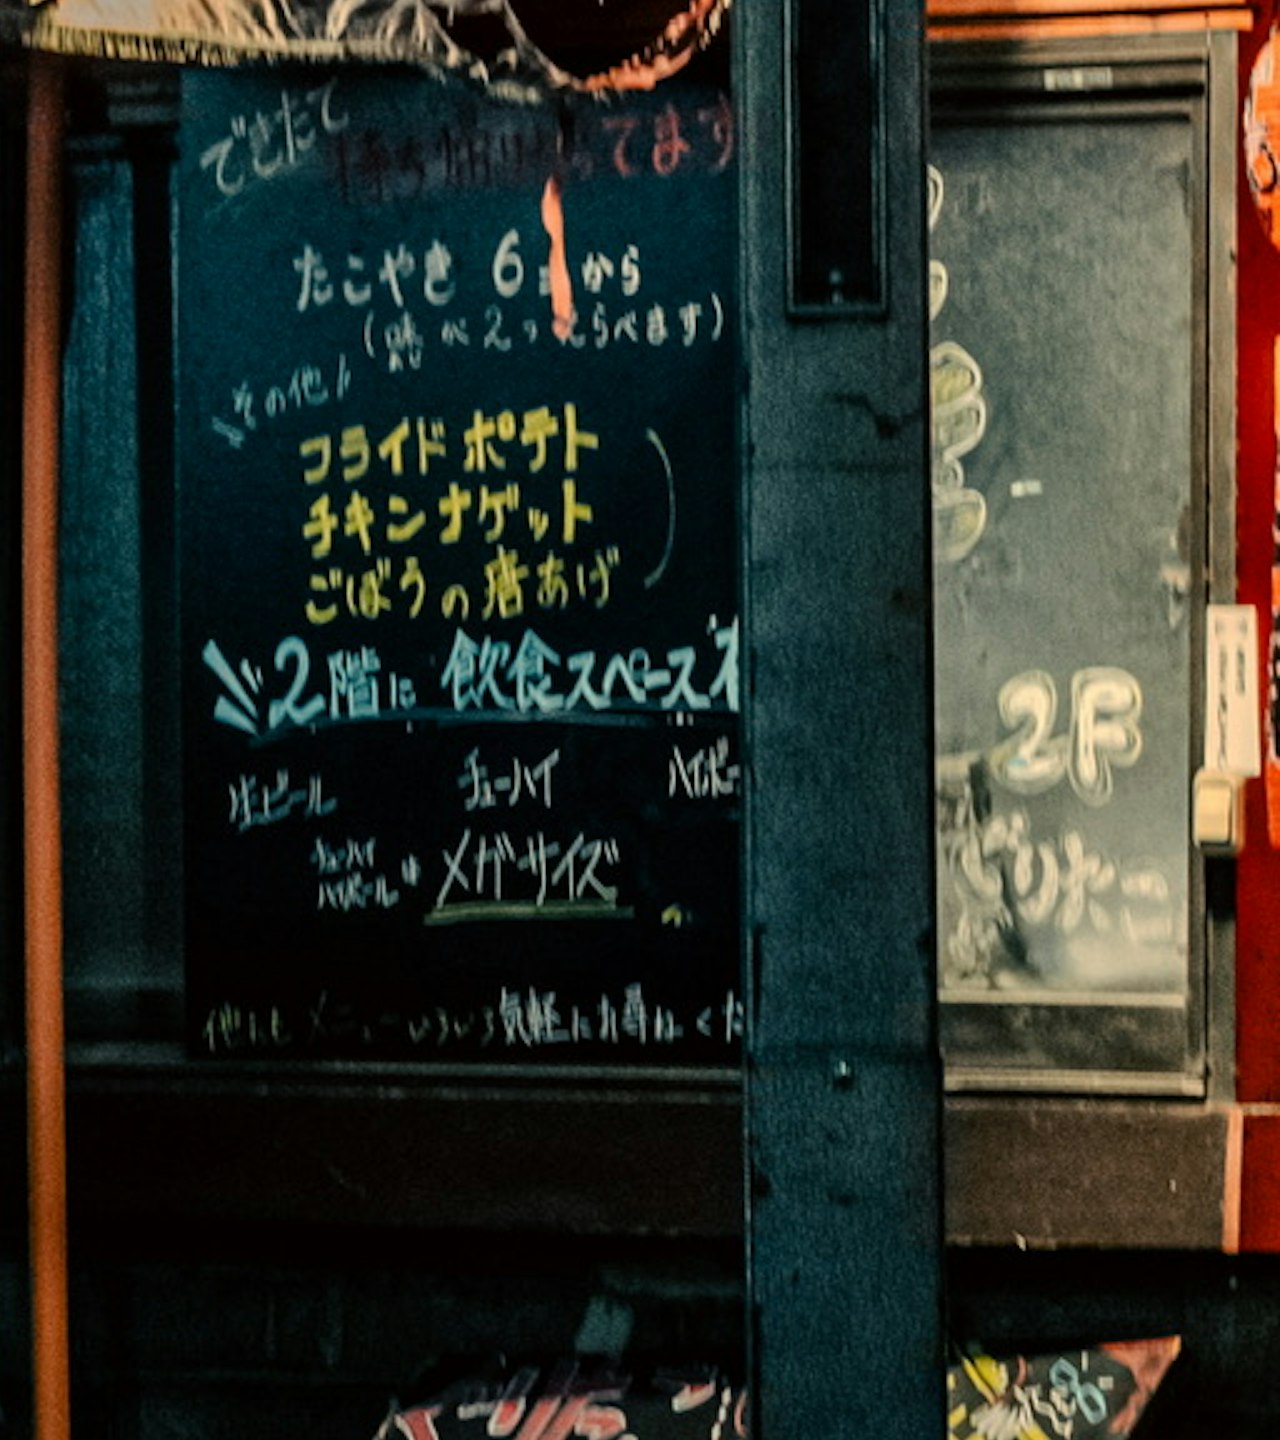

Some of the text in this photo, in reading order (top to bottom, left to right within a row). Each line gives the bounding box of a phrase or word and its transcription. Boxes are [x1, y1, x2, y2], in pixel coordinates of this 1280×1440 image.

[294, 239, 457, 311] たこやき
[301, 402, 600, 482] フライドポテト
[303, 478, 594, 558] チキンナゲット
[306, 546, 620, 623] ごぼうの唐あげ
[990, 666, 1143, 806] 2F
[438, 828, 620, 910] メガサイズ
